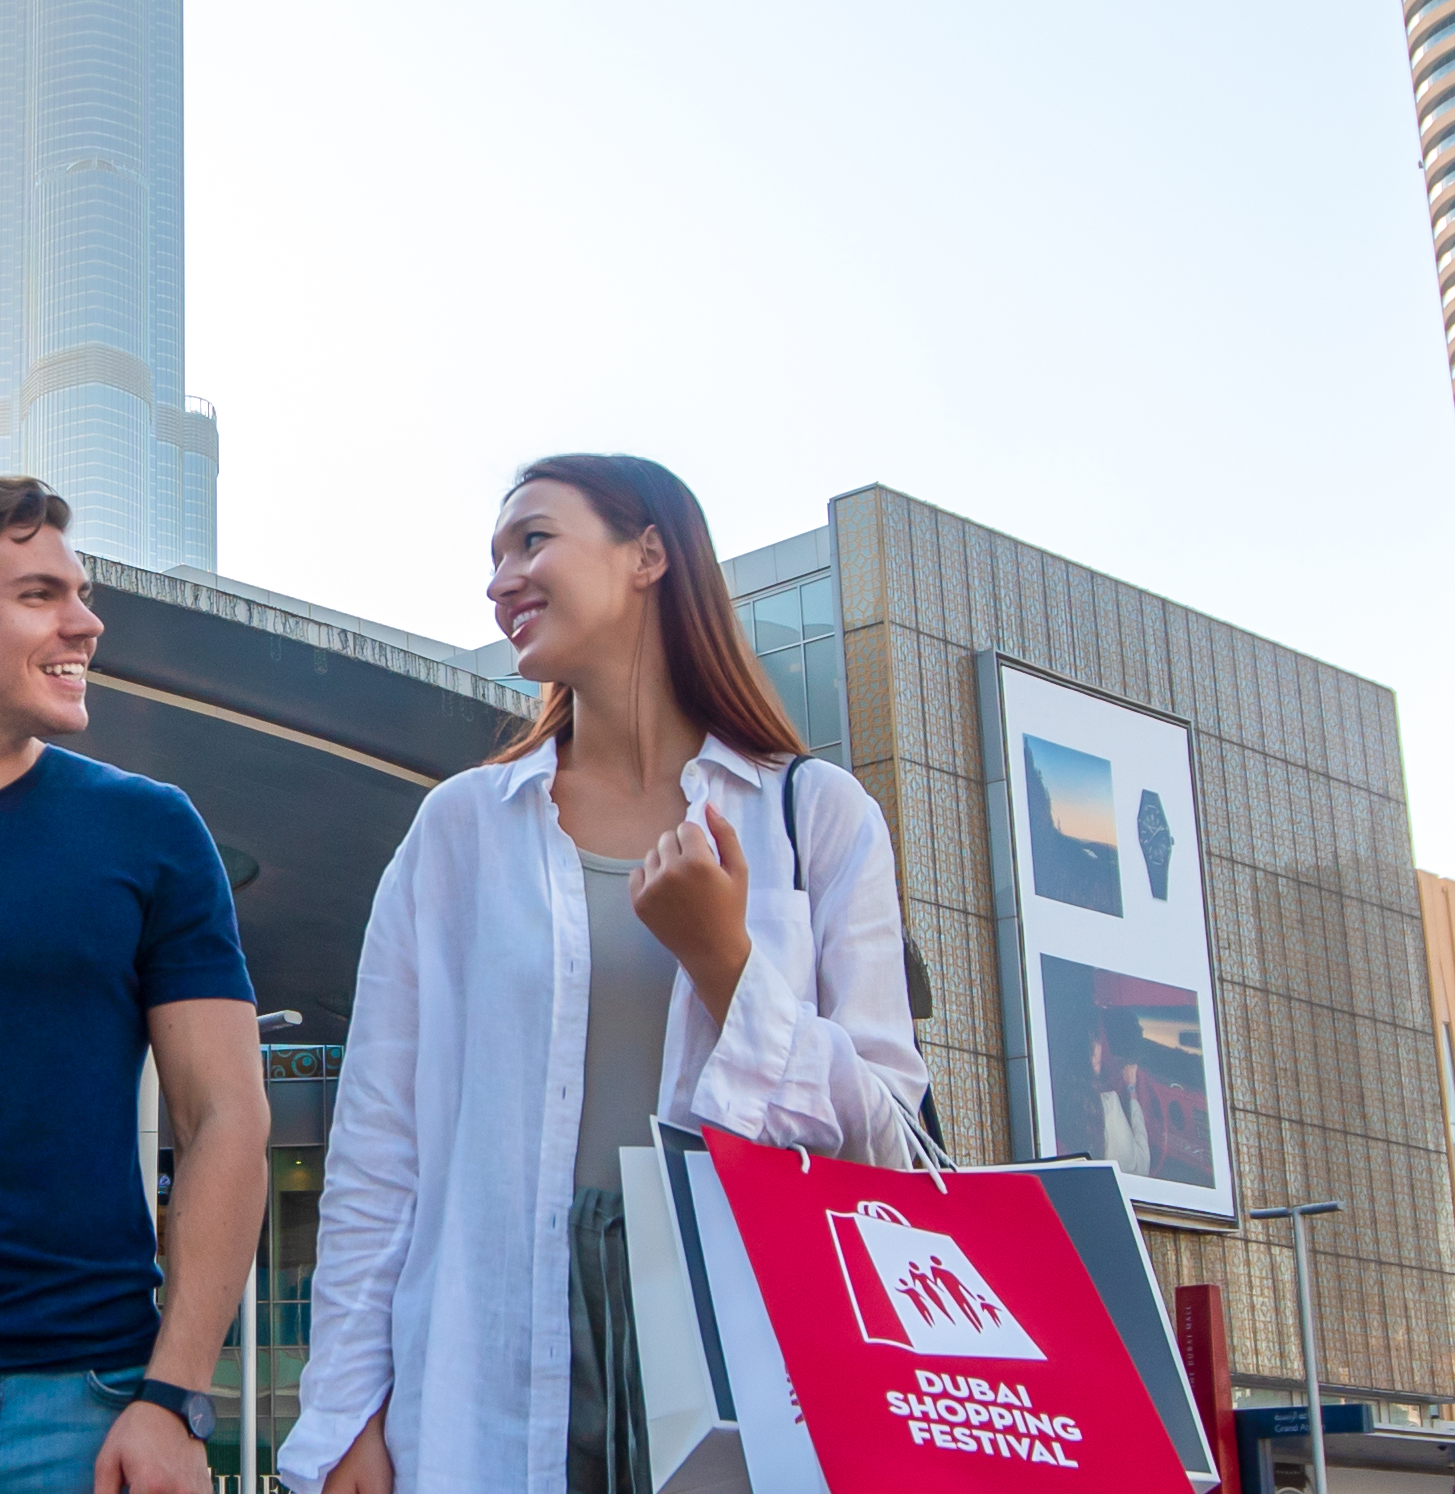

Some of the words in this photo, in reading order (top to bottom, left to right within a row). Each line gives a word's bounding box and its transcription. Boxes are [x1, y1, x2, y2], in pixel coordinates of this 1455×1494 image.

[1186, 1335, 1195, 1366] DUBAI
[914, 1368, 1032, 1409] DUBAI
[886, 1389, 1083, 1442] SHOPPING
[908, 1419, 1079, 1469] FESTIVAL
